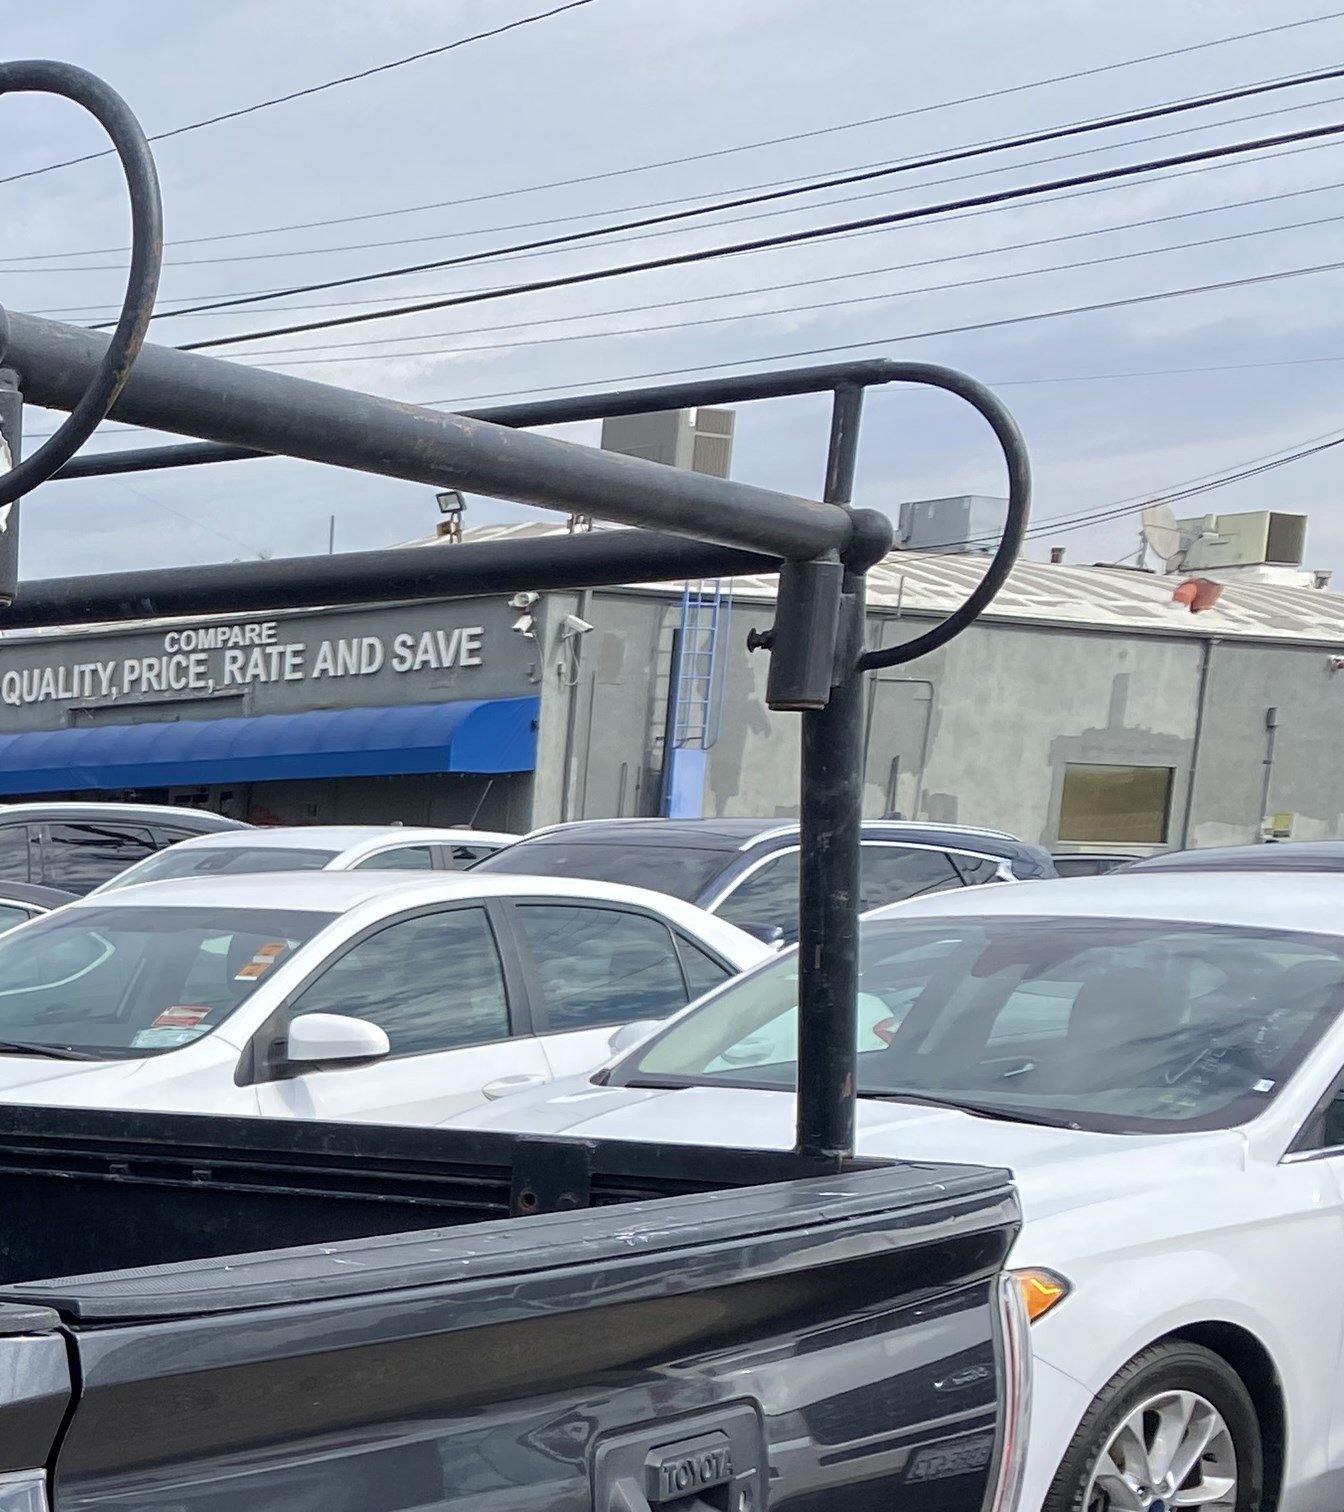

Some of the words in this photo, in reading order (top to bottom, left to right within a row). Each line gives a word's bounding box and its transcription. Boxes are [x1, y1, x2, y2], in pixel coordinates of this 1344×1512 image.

[164, 621, 279, 654] COMPARE
[0, 660, 118, 706] QUALITY,
[123, 652, 215, 694] PRICE,
[223, 643, 306, 687] RATE
[312, 636, 385, 679] AND
[392, 626, 485, 674] SAVE
[662, 1446, 733, 1494] TOYOTA
